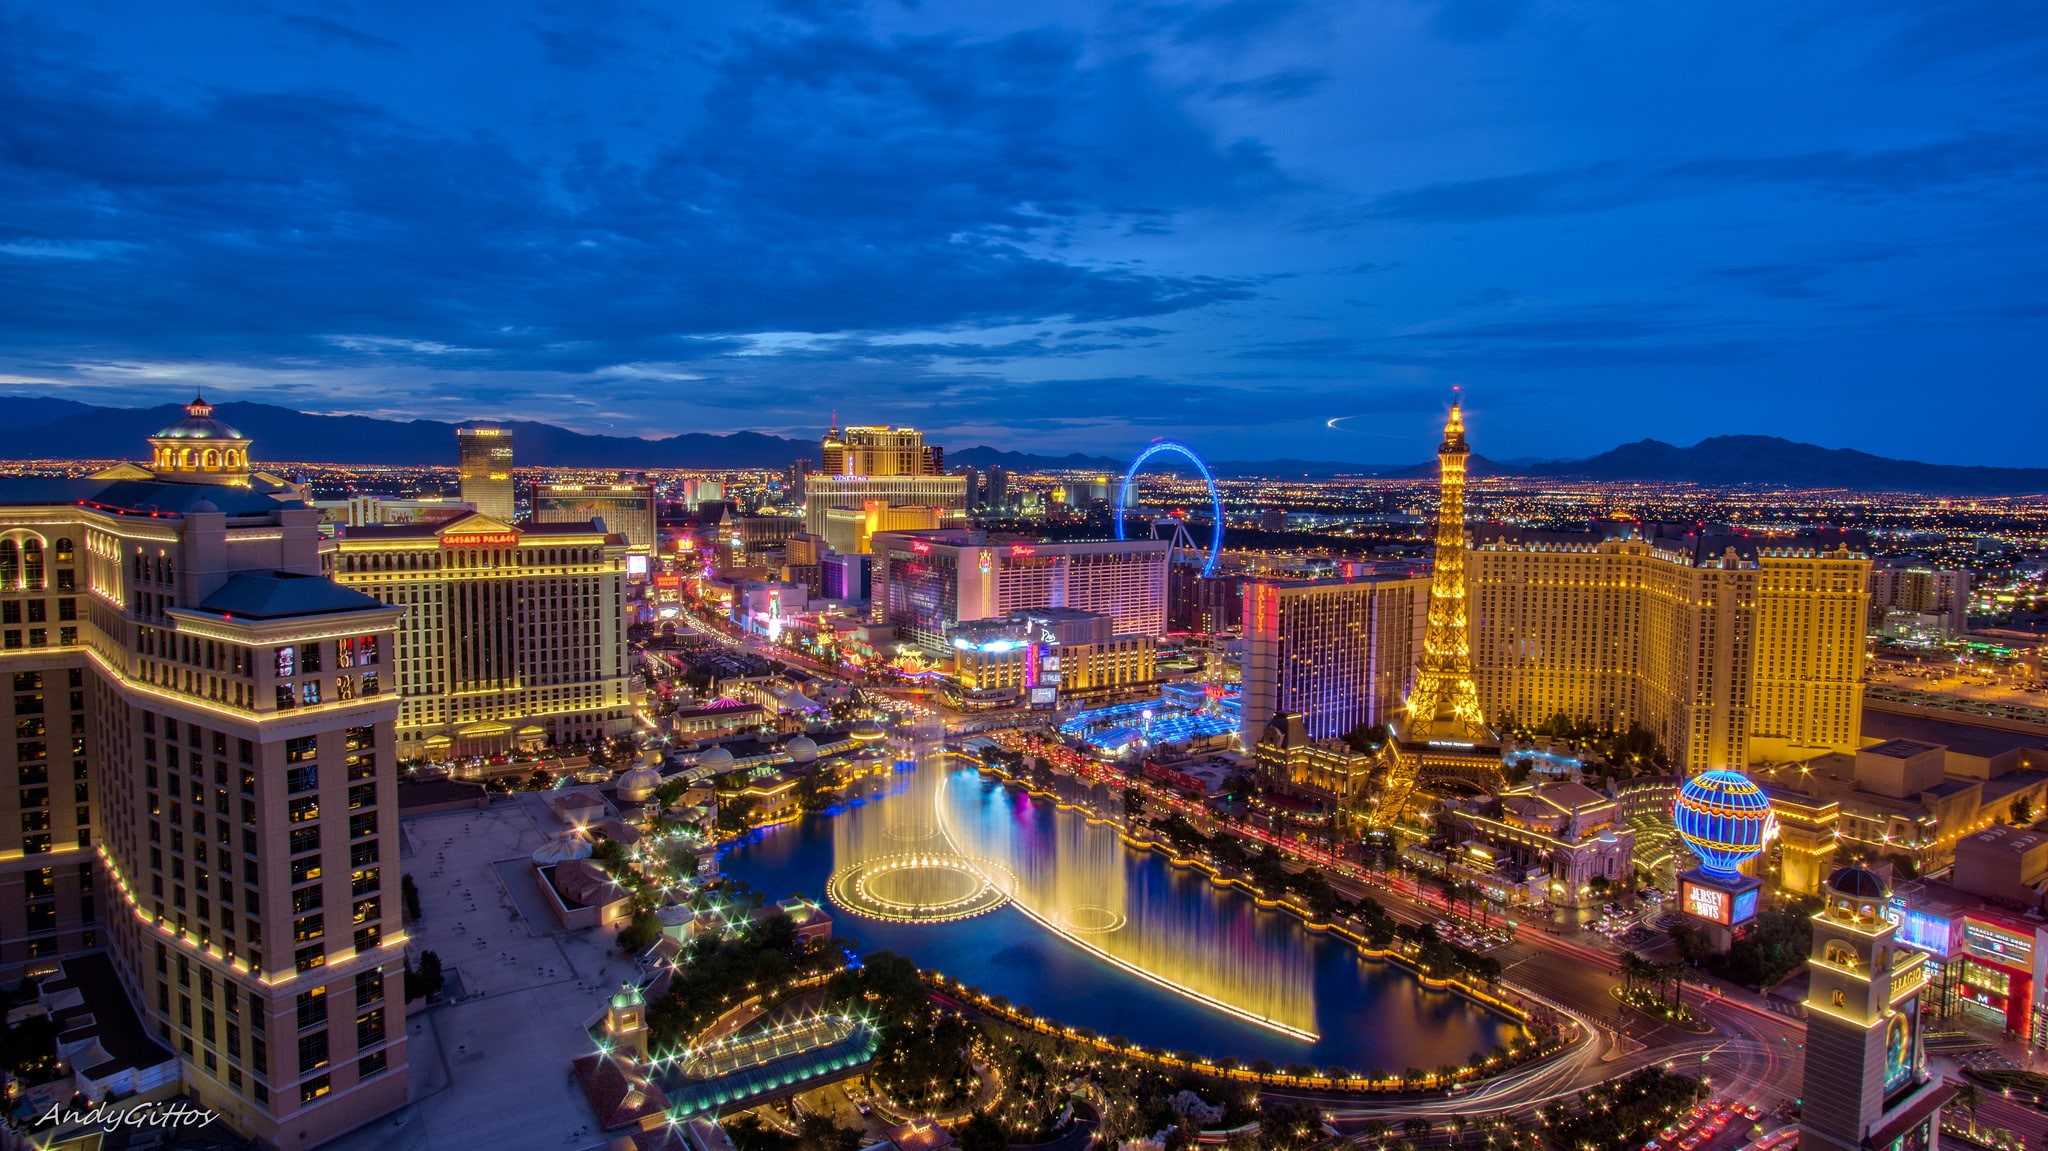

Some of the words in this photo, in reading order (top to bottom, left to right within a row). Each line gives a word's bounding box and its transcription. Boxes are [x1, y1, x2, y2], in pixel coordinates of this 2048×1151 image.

[443, 535, 481, 544] CAESARS
[483, 534, 516, 543] PALACE
[1690, 887, 1722, 907] JERSEY
[1696, 901, 1719, 919] BOYS
[1968, 925, 1994, 937] MIRACLE
[1994, 934, 2009, 942] MILE
